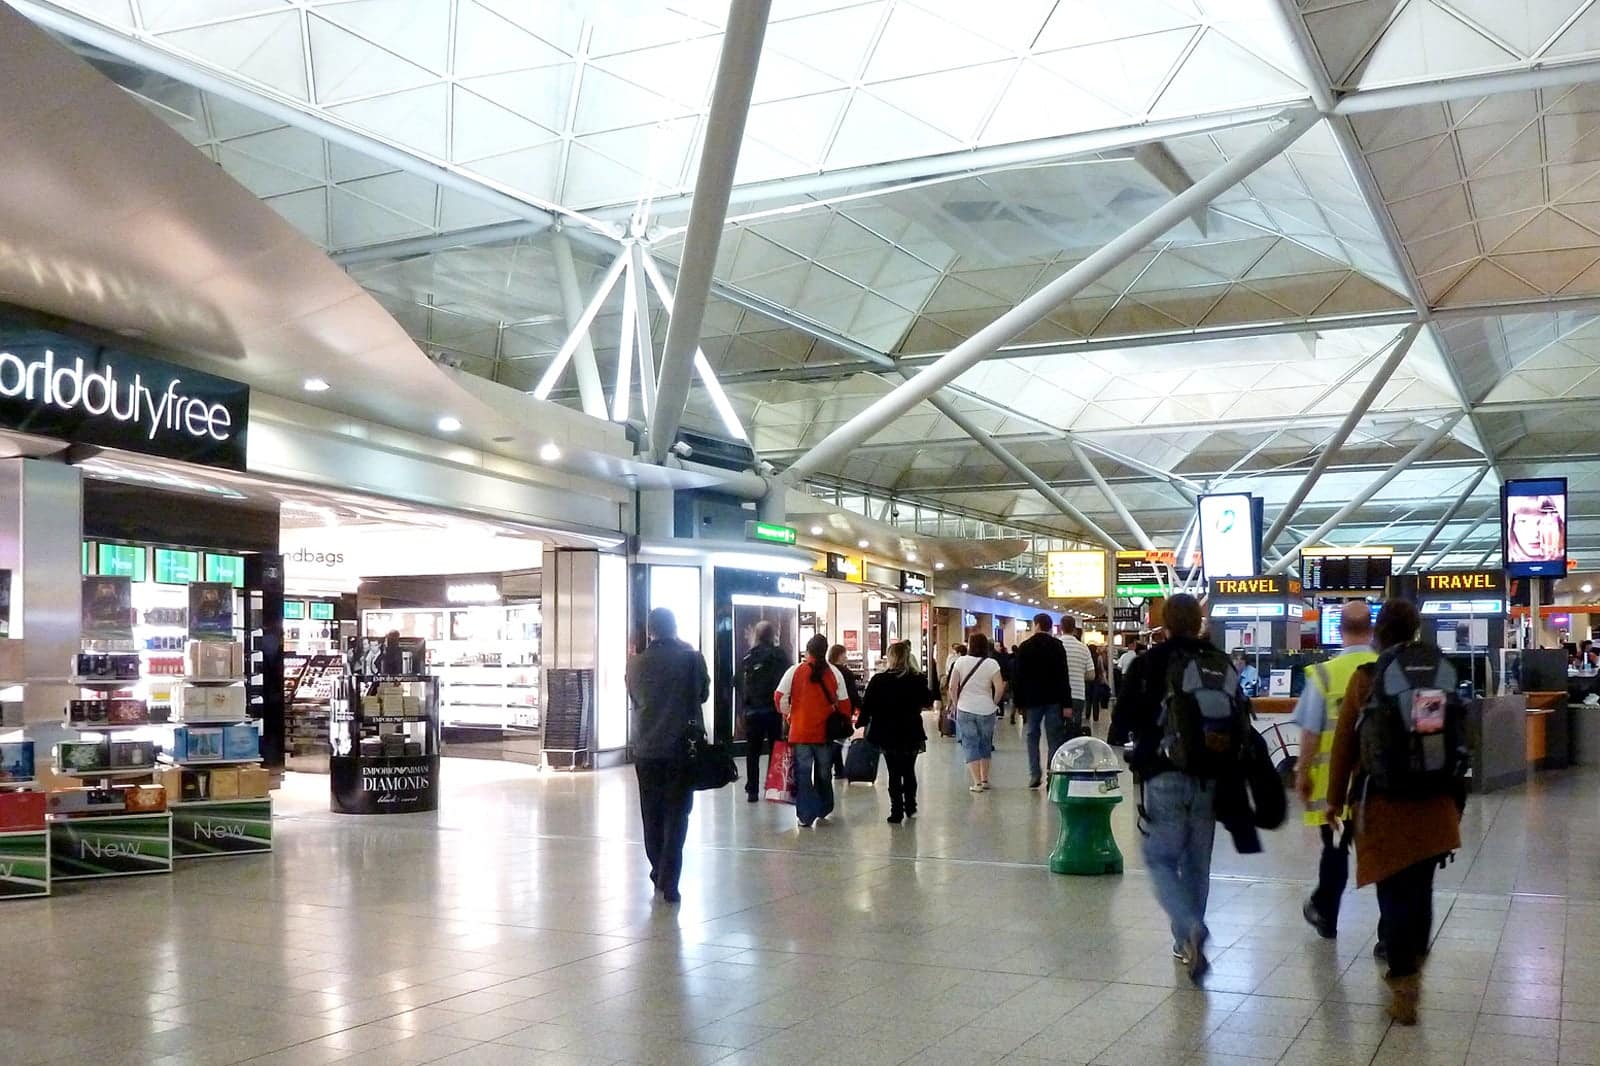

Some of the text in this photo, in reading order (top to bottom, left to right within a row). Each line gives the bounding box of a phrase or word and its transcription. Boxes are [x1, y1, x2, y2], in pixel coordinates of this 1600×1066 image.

[1216, 580, 1279, 593] TRAVEL
[1426, 574, 1496, 589] TRAVEL
[363, 776, 430, 791] DIAMONDS
[193, 821, 246, 841] New
[80, 838, 142, 860] New
